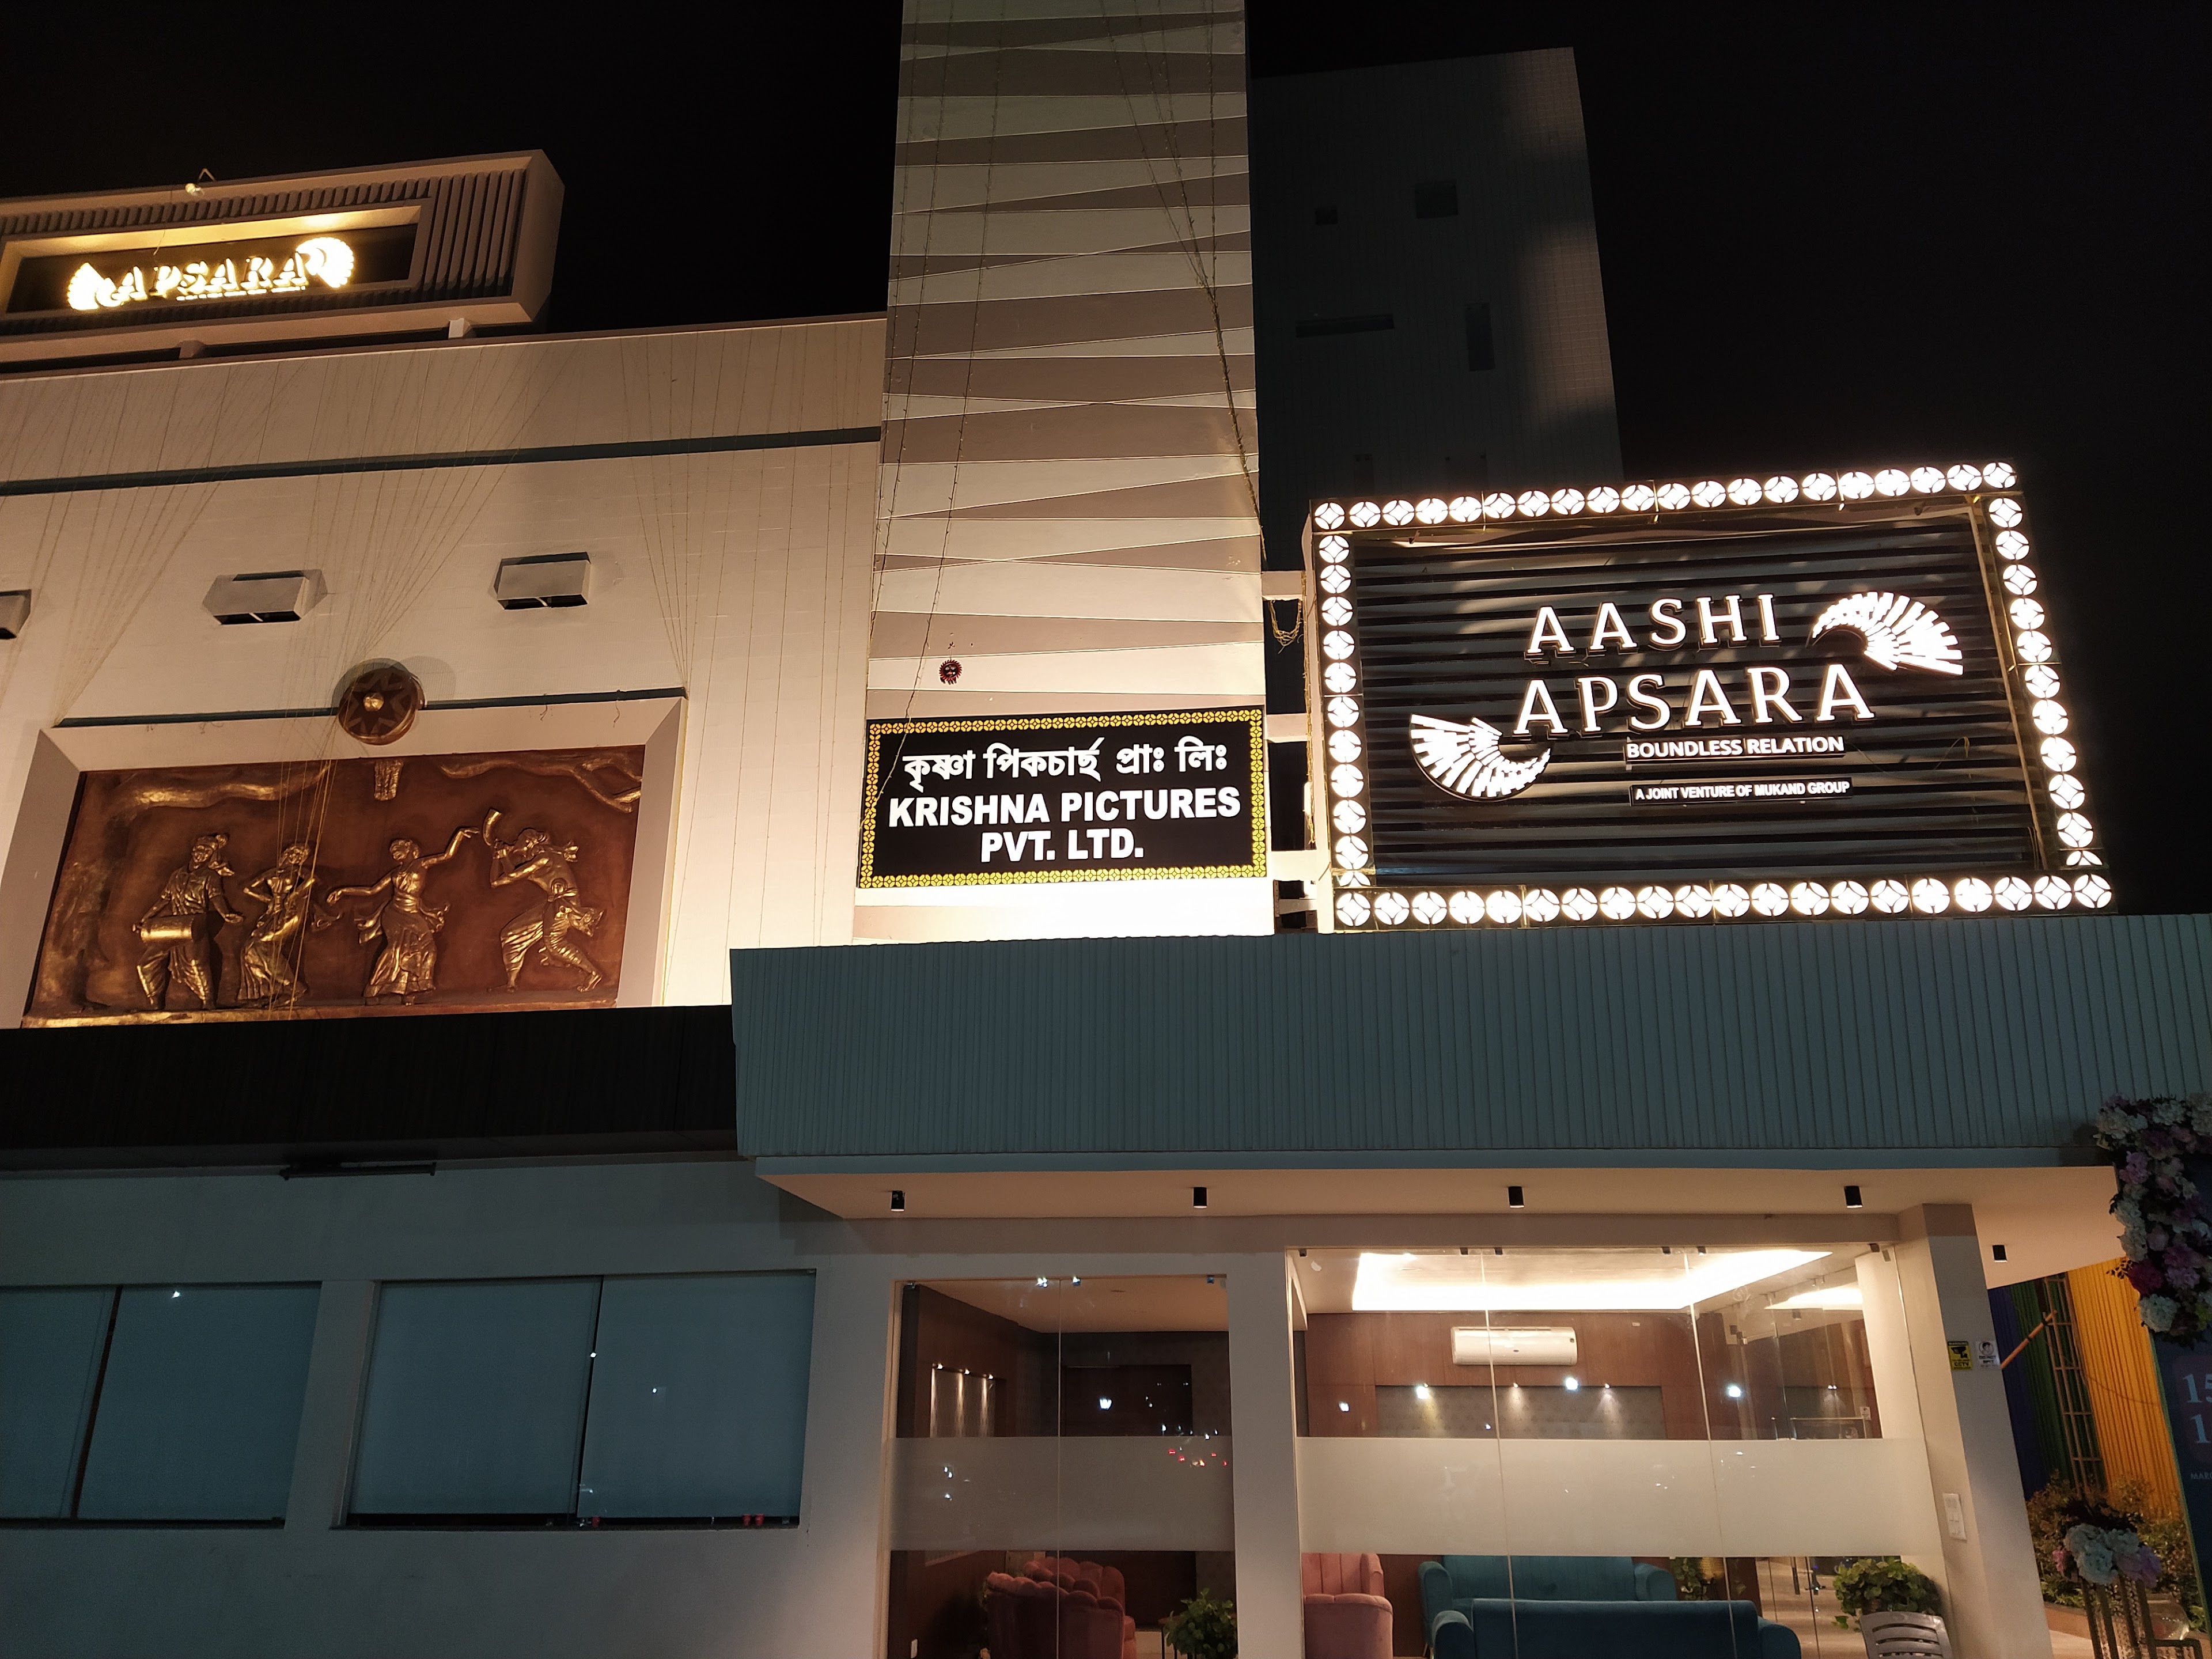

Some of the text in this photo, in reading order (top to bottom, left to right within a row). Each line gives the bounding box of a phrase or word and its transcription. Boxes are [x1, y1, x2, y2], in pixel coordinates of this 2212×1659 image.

[116, 252, 309, 301] APSARA
[1527, 594, 1781, 653] AASHI
[1513, 664, 1876, 735] APSARA
[1626, 736, 1844, 759] BOUNDLESS RELATION
[889, 786, 1241, 827] KRISHNA PICTURES
[1635, 781, 1850, 800] A JOINT VENTURE OF MUKAND GROUP
[981, 828, 1144, 862] PVT. LTD.
